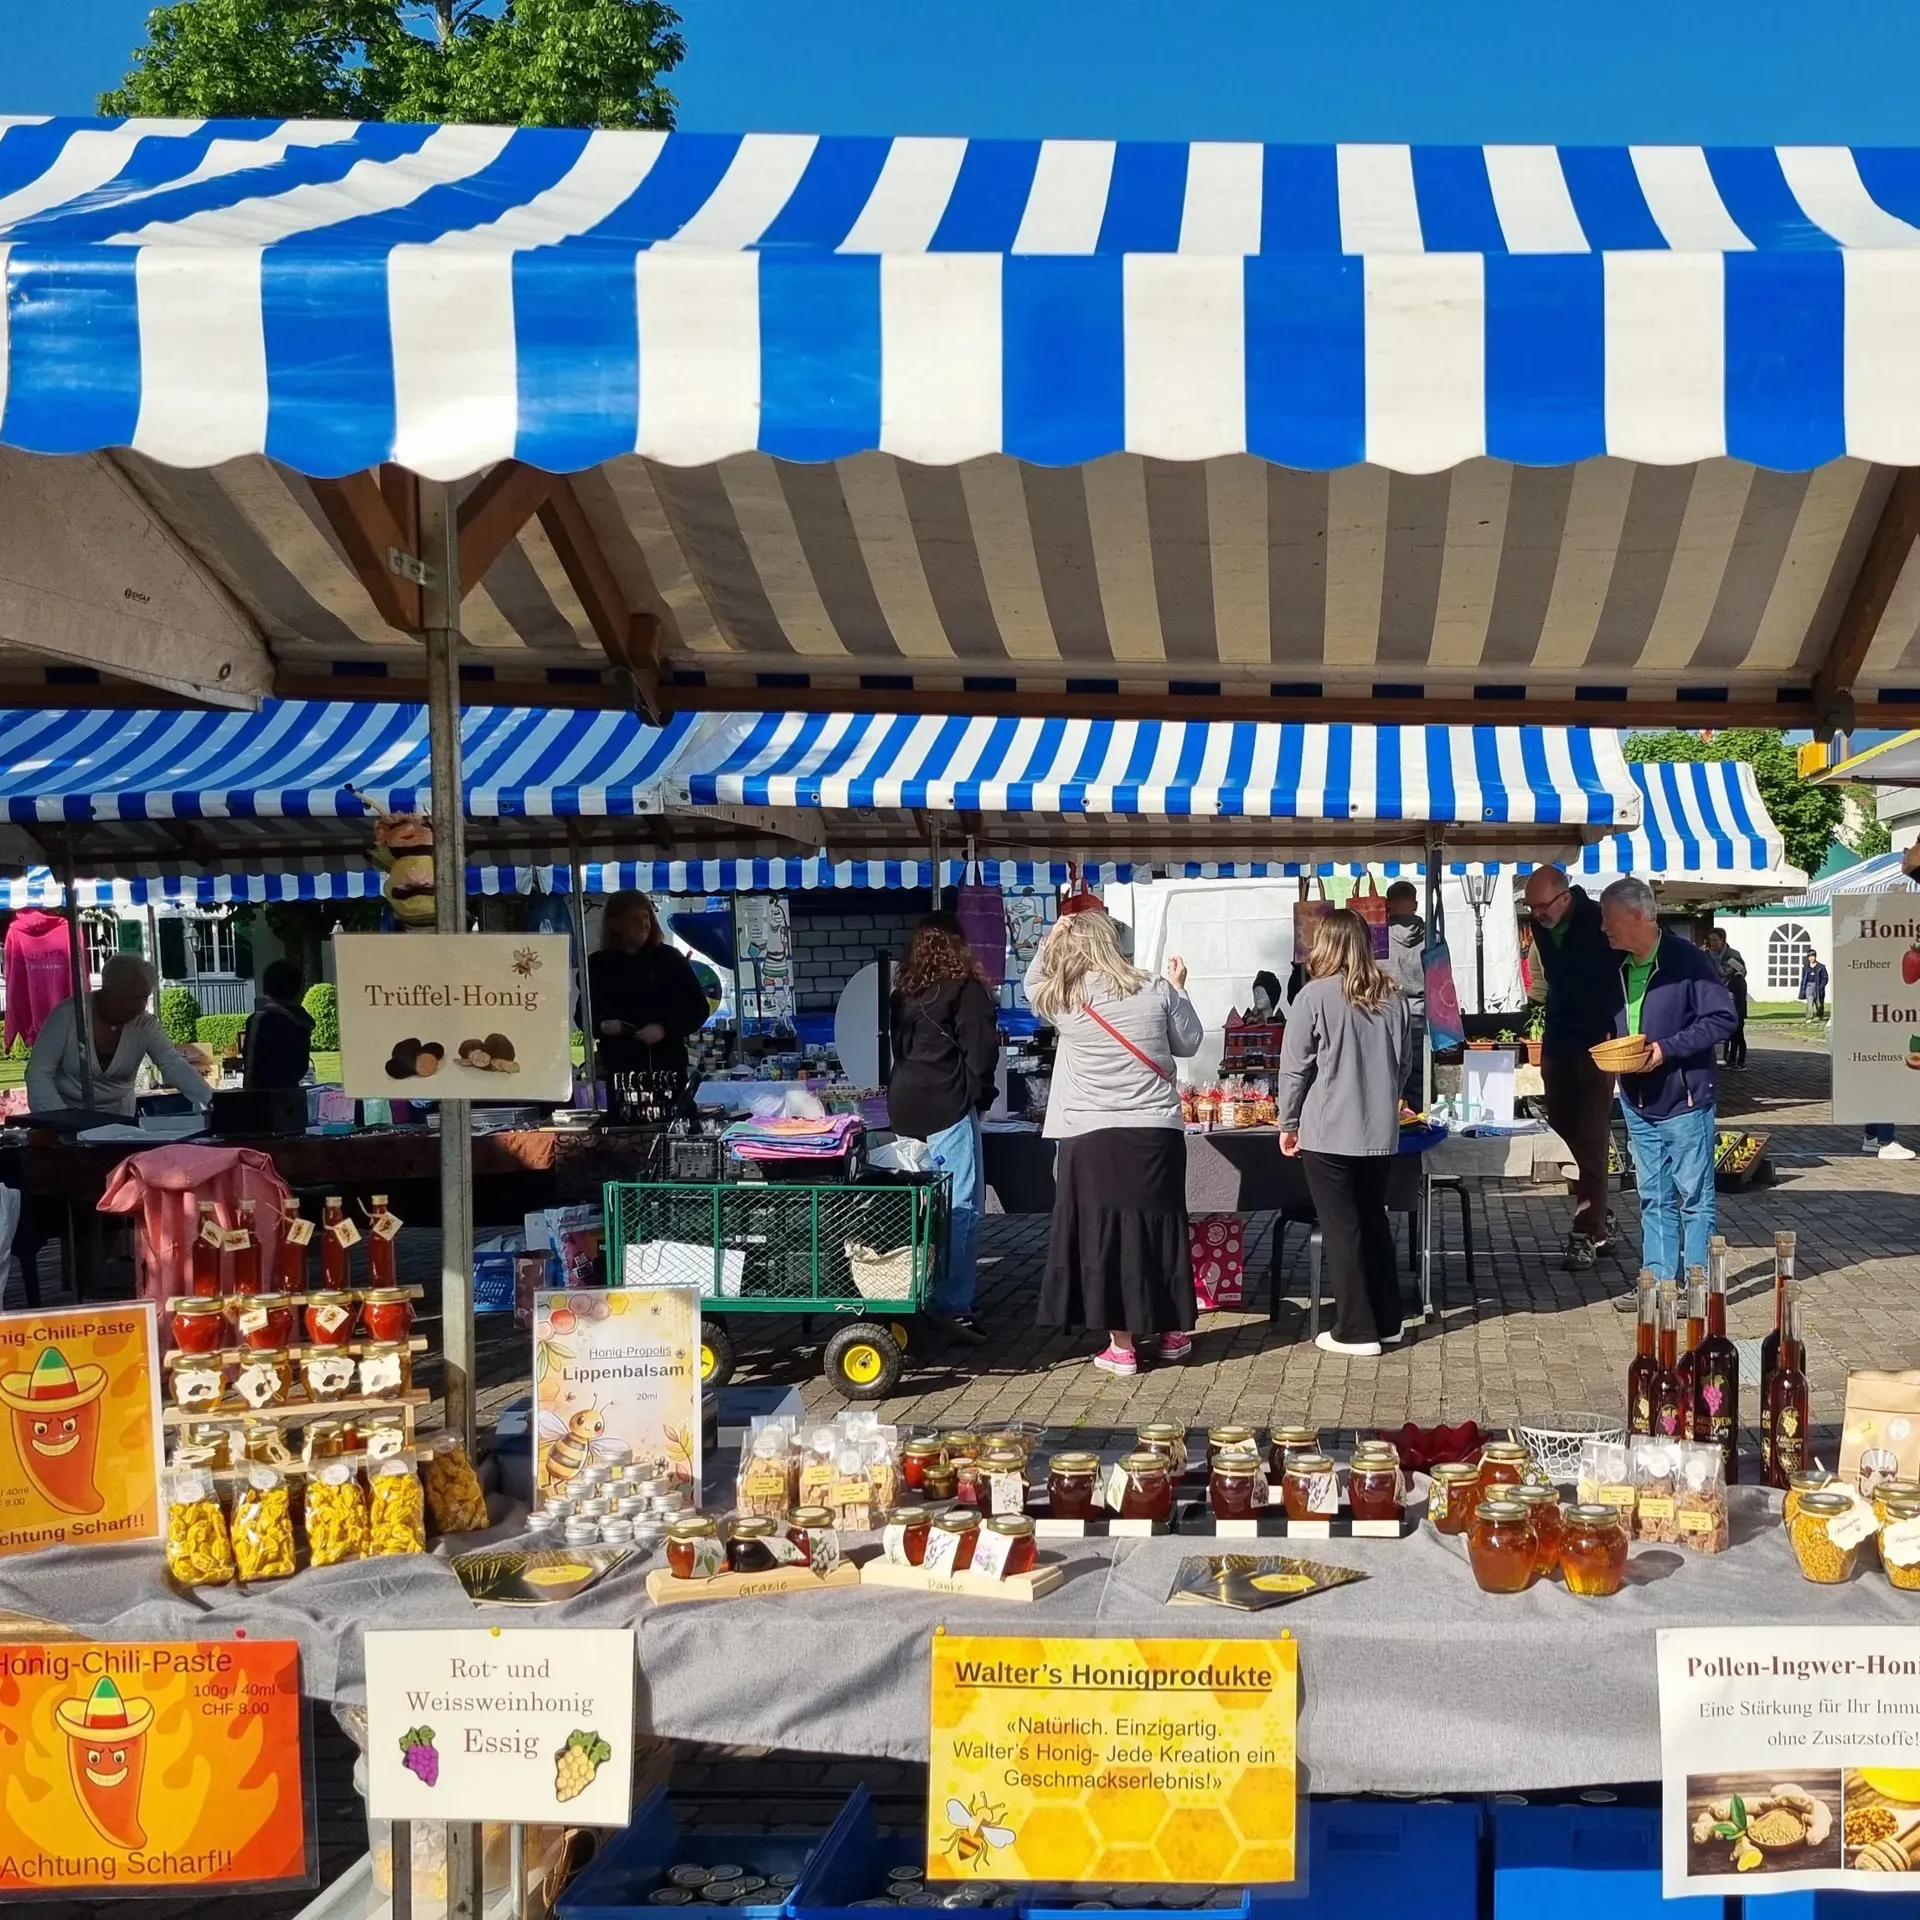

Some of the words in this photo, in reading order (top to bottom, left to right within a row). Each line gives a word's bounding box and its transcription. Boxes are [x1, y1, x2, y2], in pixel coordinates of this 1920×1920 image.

[364, 984, 538, 1012] Trüffel-Honig
[1870, 1003, 1920, 1023] Hon
[589, 1346, 672, 1359] Honig-Propolis
[563, 1364, 685, 1383] Lippenbalsam
[636, 1392, 658, 1401] 20ml
[6, 1486, 29, 1496] 40ml
[71, 1513, 145, 1536] Scharf!!
[738, 1579, 788, 1597] Grazie
[450, 1658, 498, 1678] Rot-
[507, 1658, 551, 1679] und
[955, 1661, 1063, 1684] Walter’s
[1072, 1663, 1273, 1689] Honigprodukte
[1687, 1655, 1920, 1680] Pollen-Ingwer-Hon
[193, 1685, 229, 1699] 100g
[241, 1683, 276, 1697] 40ml
[202, 1703, 235, 1716] CHF
[238, 1702, 270, 1716] 8.00
[406, 1691, 595, 1717] Weissweinhonig
[1699, 1702, 1735, 1718] Eine
[1740, 1700, 1813, 1718] Stärkung
[1818, 1698, 1842, 1714] für
[1847, 1698, 1871, 1714] Ihr
[1006, 1716, 1109, 1736] «Natürlich.
[1115, 1718, 1223, 1741] Einzigartig.
[1767, 1731, 1807, 1746] ohne
[1812, 1730, 1919, 1746] Zusatzstoffe!
[463, 1728, 540, 1760] Essig
[952, 1740, 1030, 1761] Walter’s
[1036, 1743, 1100, 1766] Honig-
[1106, 1745, 1153, 1763] Jede
[1160, 1746, 1241, 1764] Kreation
[1247, 1748, 1276, 1764] ein
[1004, 1769, 1223, 1791] Geschmackserlebnis!»
[0, 1853, 117, 1880] Achtung
[127, 1850, 233, 1874] Scharf!!
